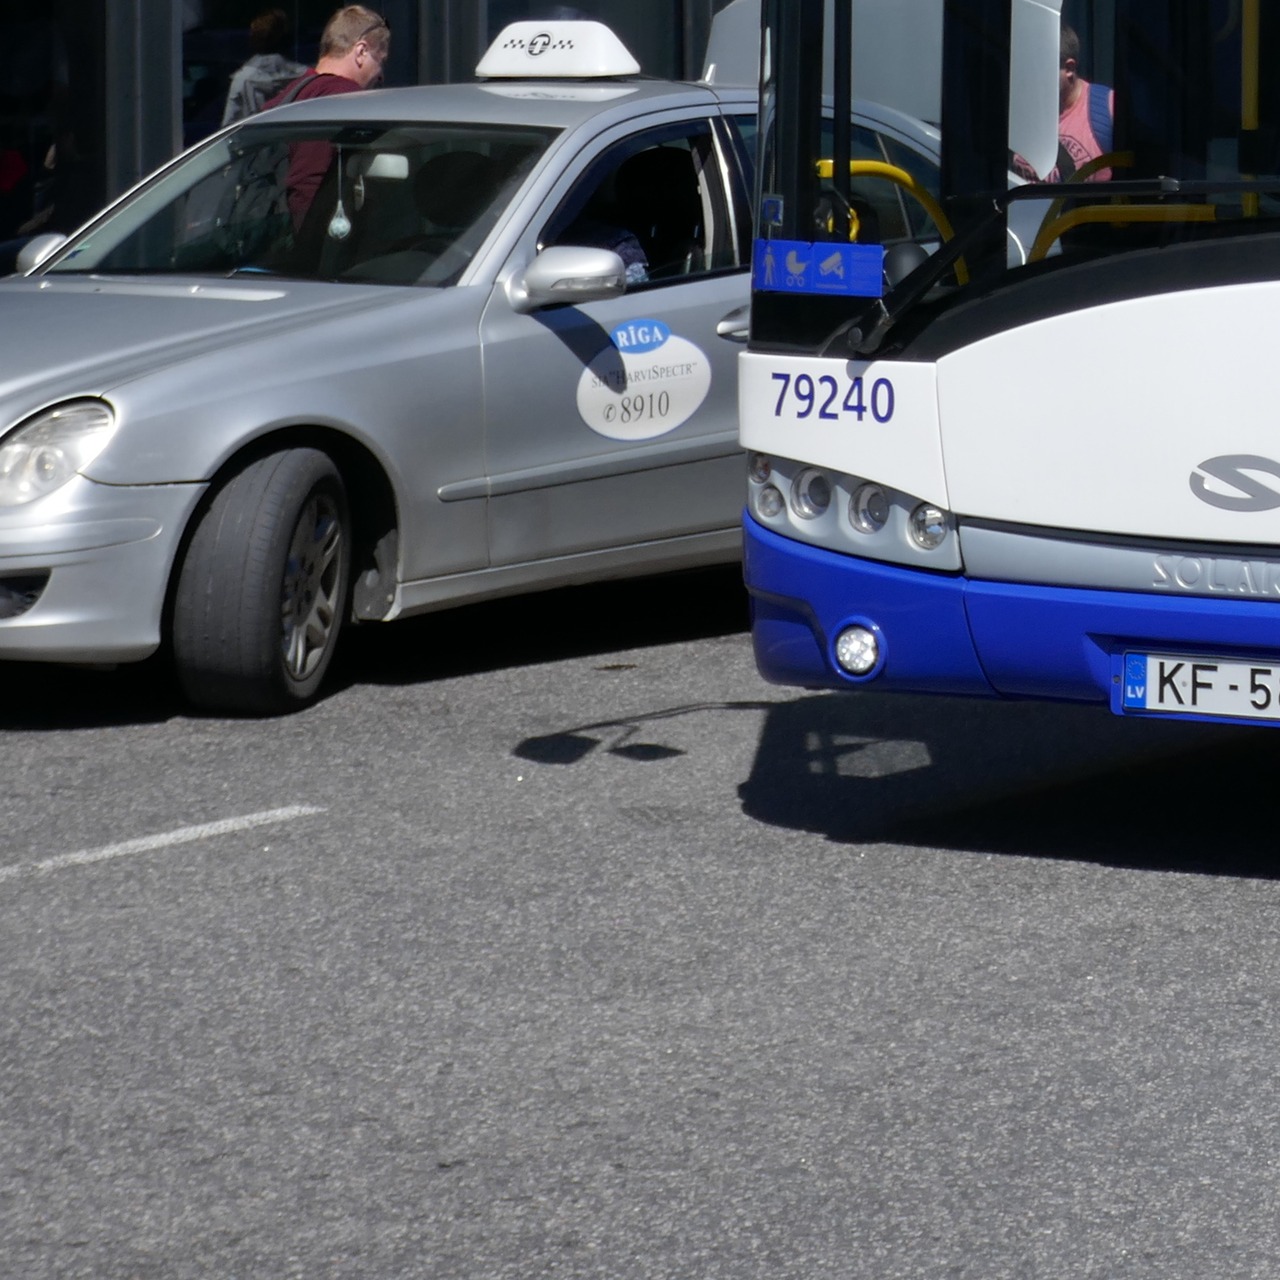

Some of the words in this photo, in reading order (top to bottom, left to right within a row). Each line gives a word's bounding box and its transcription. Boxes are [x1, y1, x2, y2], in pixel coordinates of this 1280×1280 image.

[616, 325, 664, 348] RĪGA
[620, 390, 670, 424] 8910
[771, 371, 896, 424] 79240
[1127, 686, 1145, 698] LV
